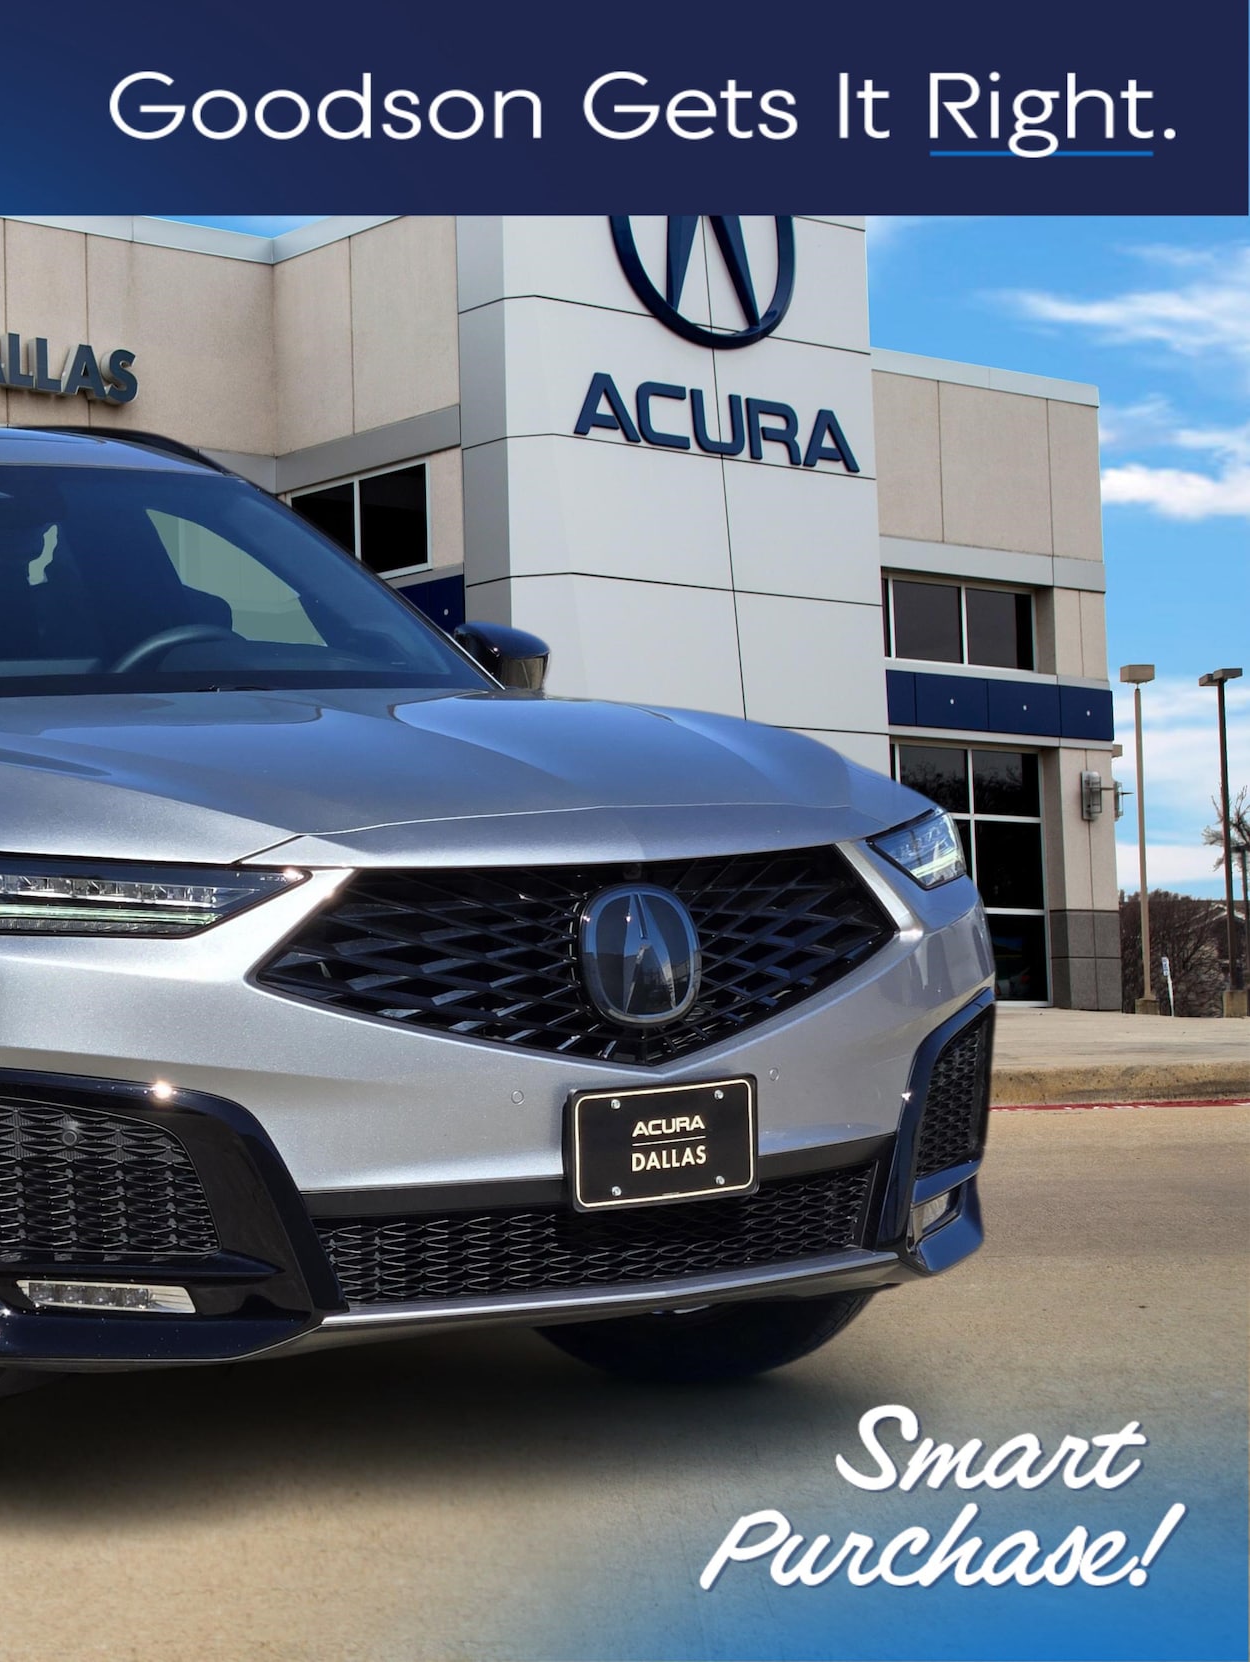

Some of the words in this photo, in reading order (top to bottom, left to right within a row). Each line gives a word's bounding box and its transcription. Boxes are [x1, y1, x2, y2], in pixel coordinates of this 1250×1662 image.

[573, 372, 860, 472] ACURA
[632, 1115, 705, 1137] ACURA
[631, 1145, 707, 1172] DALLAS
